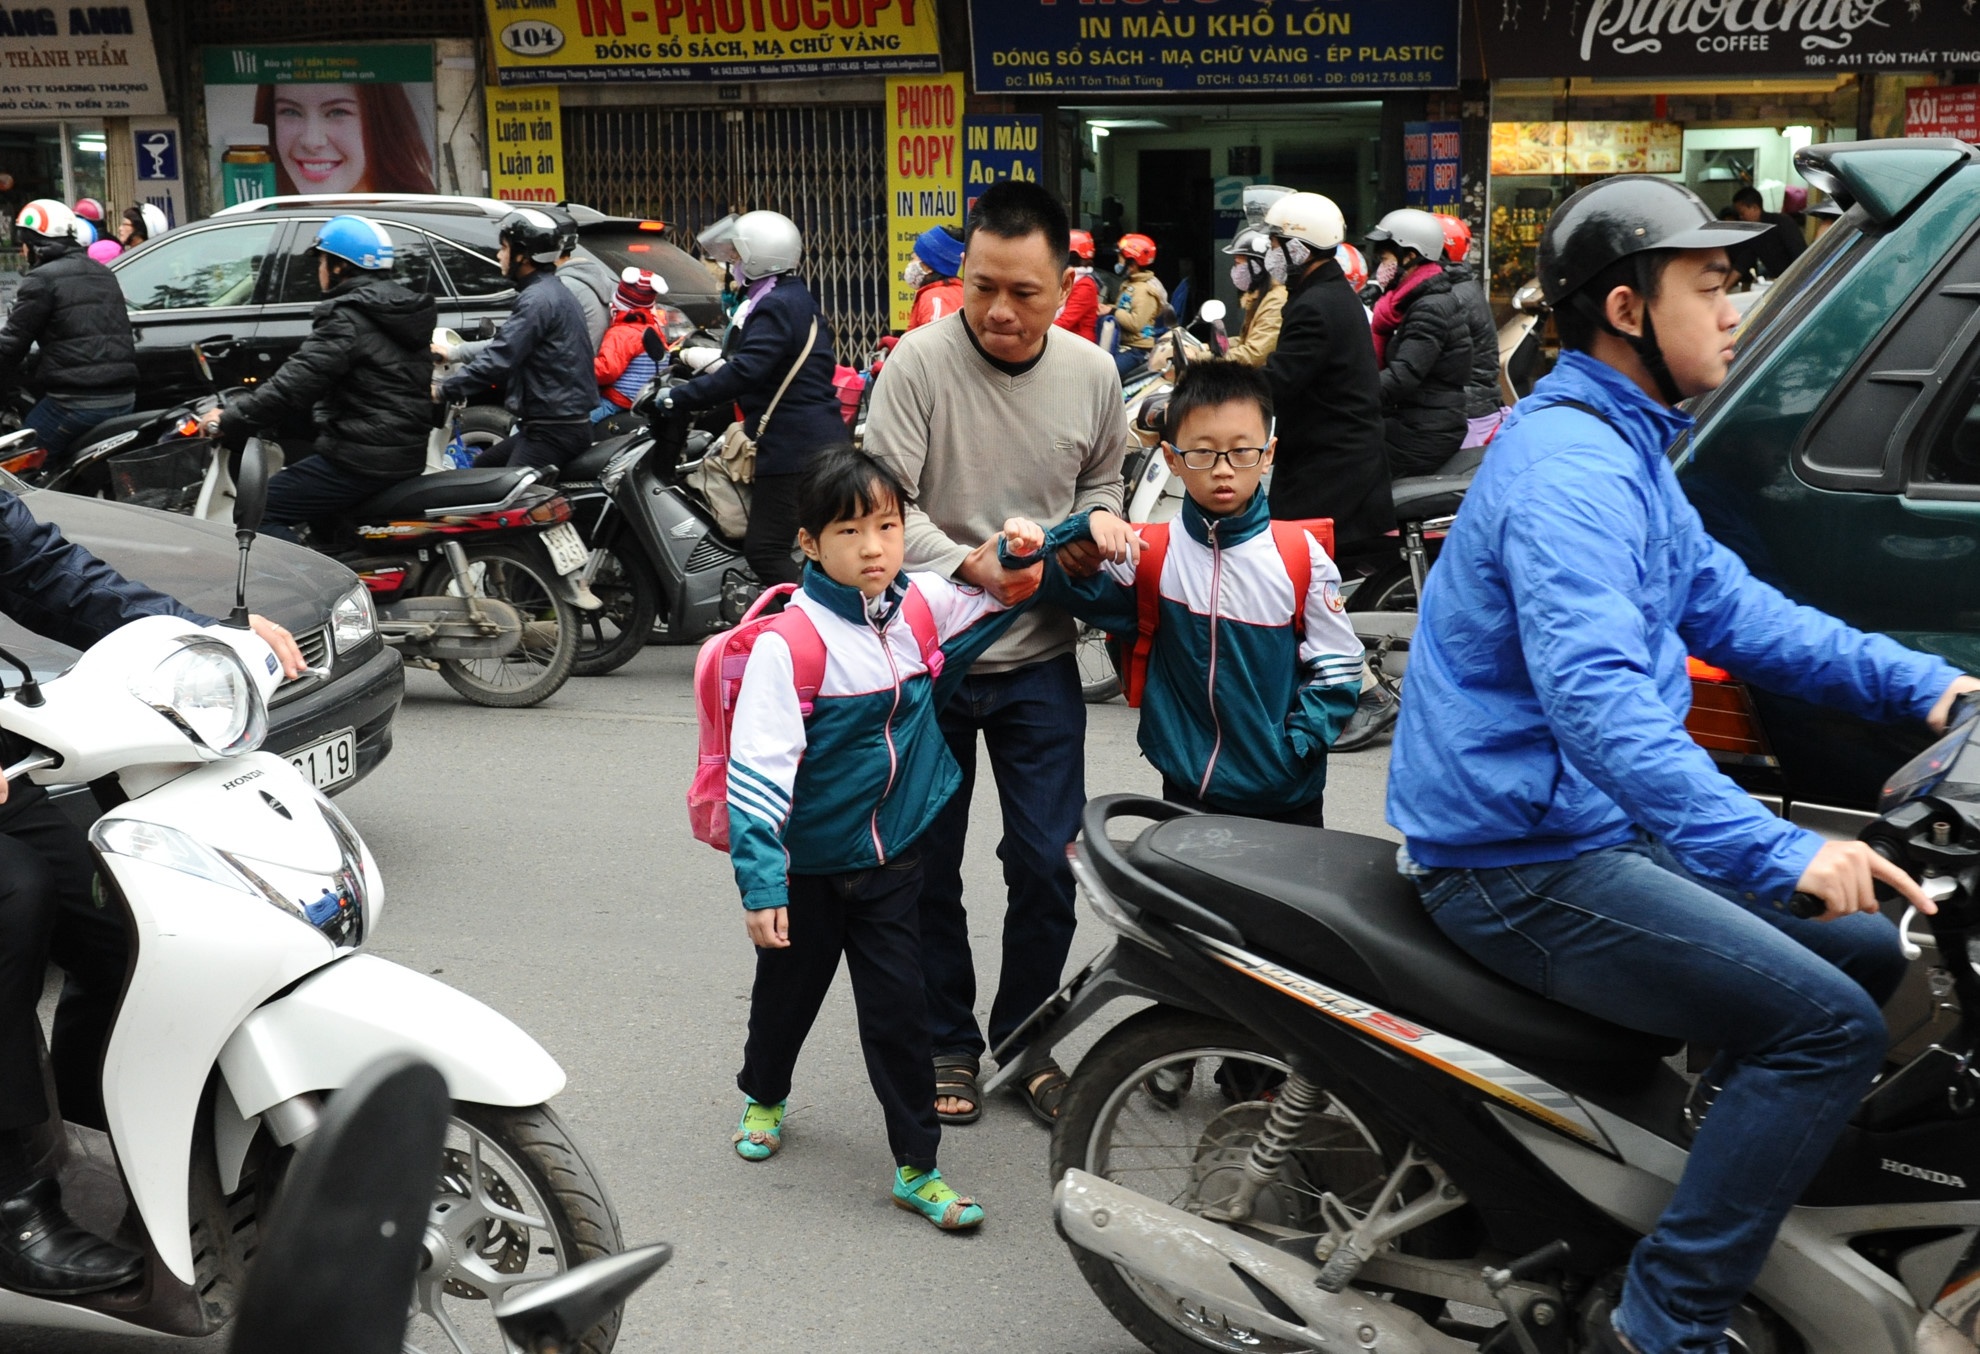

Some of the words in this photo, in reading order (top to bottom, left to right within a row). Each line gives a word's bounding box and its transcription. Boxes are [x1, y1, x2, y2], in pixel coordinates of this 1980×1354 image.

[69, 6, 134, 36] ANH
[576, 0, 627, 37] IN
[1080, 16, 1111, 38] IN
[1121, 10, 1195, 38] MÀU
[1208, 1, 1275, 37] KHỔ
[1285, 6, 1351, 36] LỚN
[509, 28, 556, 48] 104
[594, 39, 652, 60] ĐÓNG
[656, 35, 683, 58] SỔ
[687, 38, 748, 59] SÁCH,
[752, 39, 785, 58] MẠ
[789, 33, 835, 54] CHỮ
[839, 31, 901, 51] VÀNG
[1696, 34, 1770, 53] COFFEE
[5, 45, 71, 69] THÀNH
[74, 40, 130, 67] PHẨM
[991, 47, 1050, 66] ĐÓNG
[1055, 42, 1083, 66] SỔ
[1088, 47, 1144, 66] SÁCH
[1161, 49, 1194, 68] MẠ
[1200, 45, 1244, 64] CHỮ
[1249, 44, 1309, 64] VÀNG
[1326, 44, 1352, 63] ÉP
[1358, 45, 1445, 62] PLASTIC
[1804, 54, 1826, 66] 106
[1837, 53, 1862, 65] A11
[1900, 49, 1937, 63] THẤT
[1028, 72, 1053, 86] 105
[1055, 76, 1077, 86] A11
[1081, 74, 1102, 86] Tôn
[1106, 73, 1131, 86] Thất
[1134, 74, 1164, 88] Tùng
[106, 101, 130, 110] 22h
[896, 84, 955, 129] PHOTO
[1907, 90, 1938, 124] XÔI
[496, 116, 527, 147] Luận
[529, 116, 553, 141] văn
[968, 126, 988, 151] IN
[994, 121, 1038, 151] MÀU
[1431, 132, 1460, 160] PHOTO
[498, 151, 532, 180] Luận
[536, 150, 554, 174] án
[897, 134, 956, 179] COPY
[1010, 159, 1035, 184] A4
[1433, 162, 1458, 192] COPY
[896, 191, 914, 217] IN
[920, 185, 957, 217] MÀU
[222, 769, 265, 791] HONDA
[1879, 1158, 1968, 1189] HONDA
